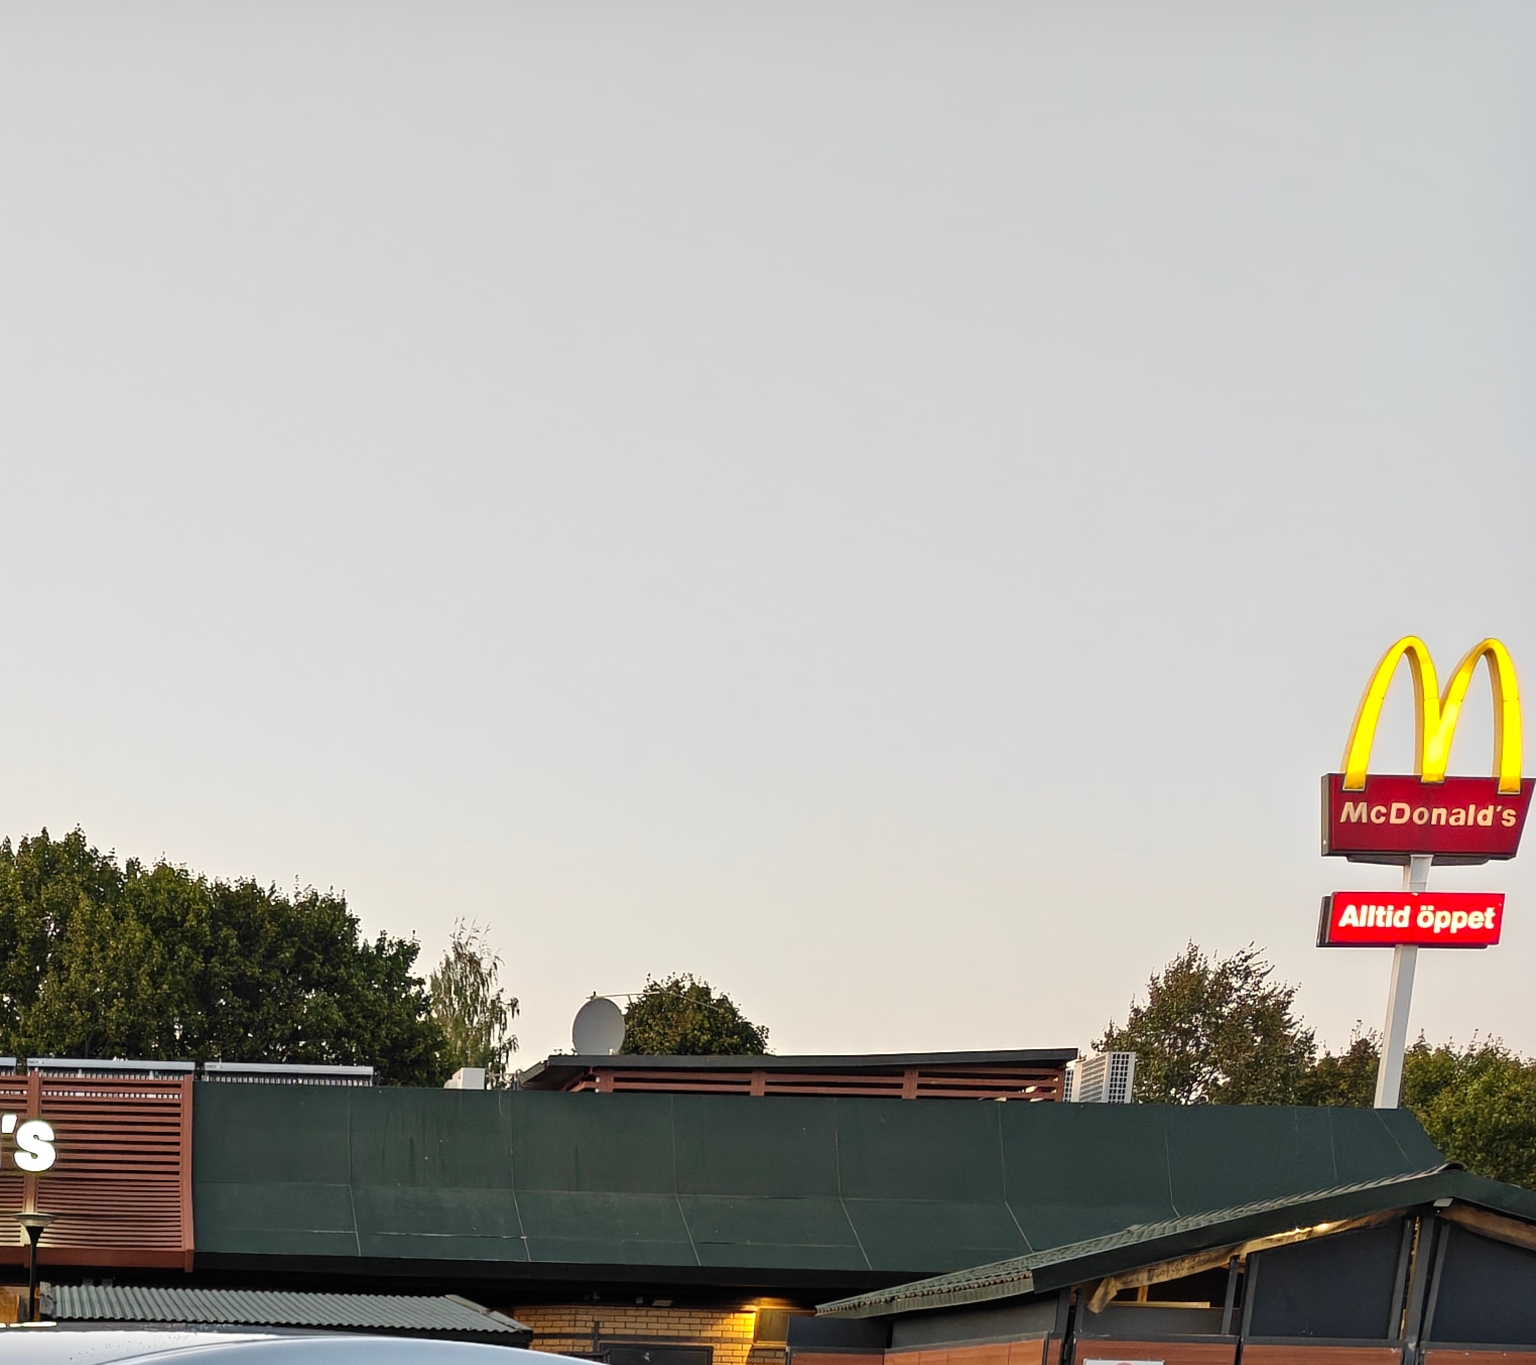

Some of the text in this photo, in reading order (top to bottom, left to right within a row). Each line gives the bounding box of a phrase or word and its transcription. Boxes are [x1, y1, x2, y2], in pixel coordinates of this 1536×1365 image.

[1339, 801, 1517, 827] McDonald's
[1338, 904, 1496, 934] Alltid öppet
